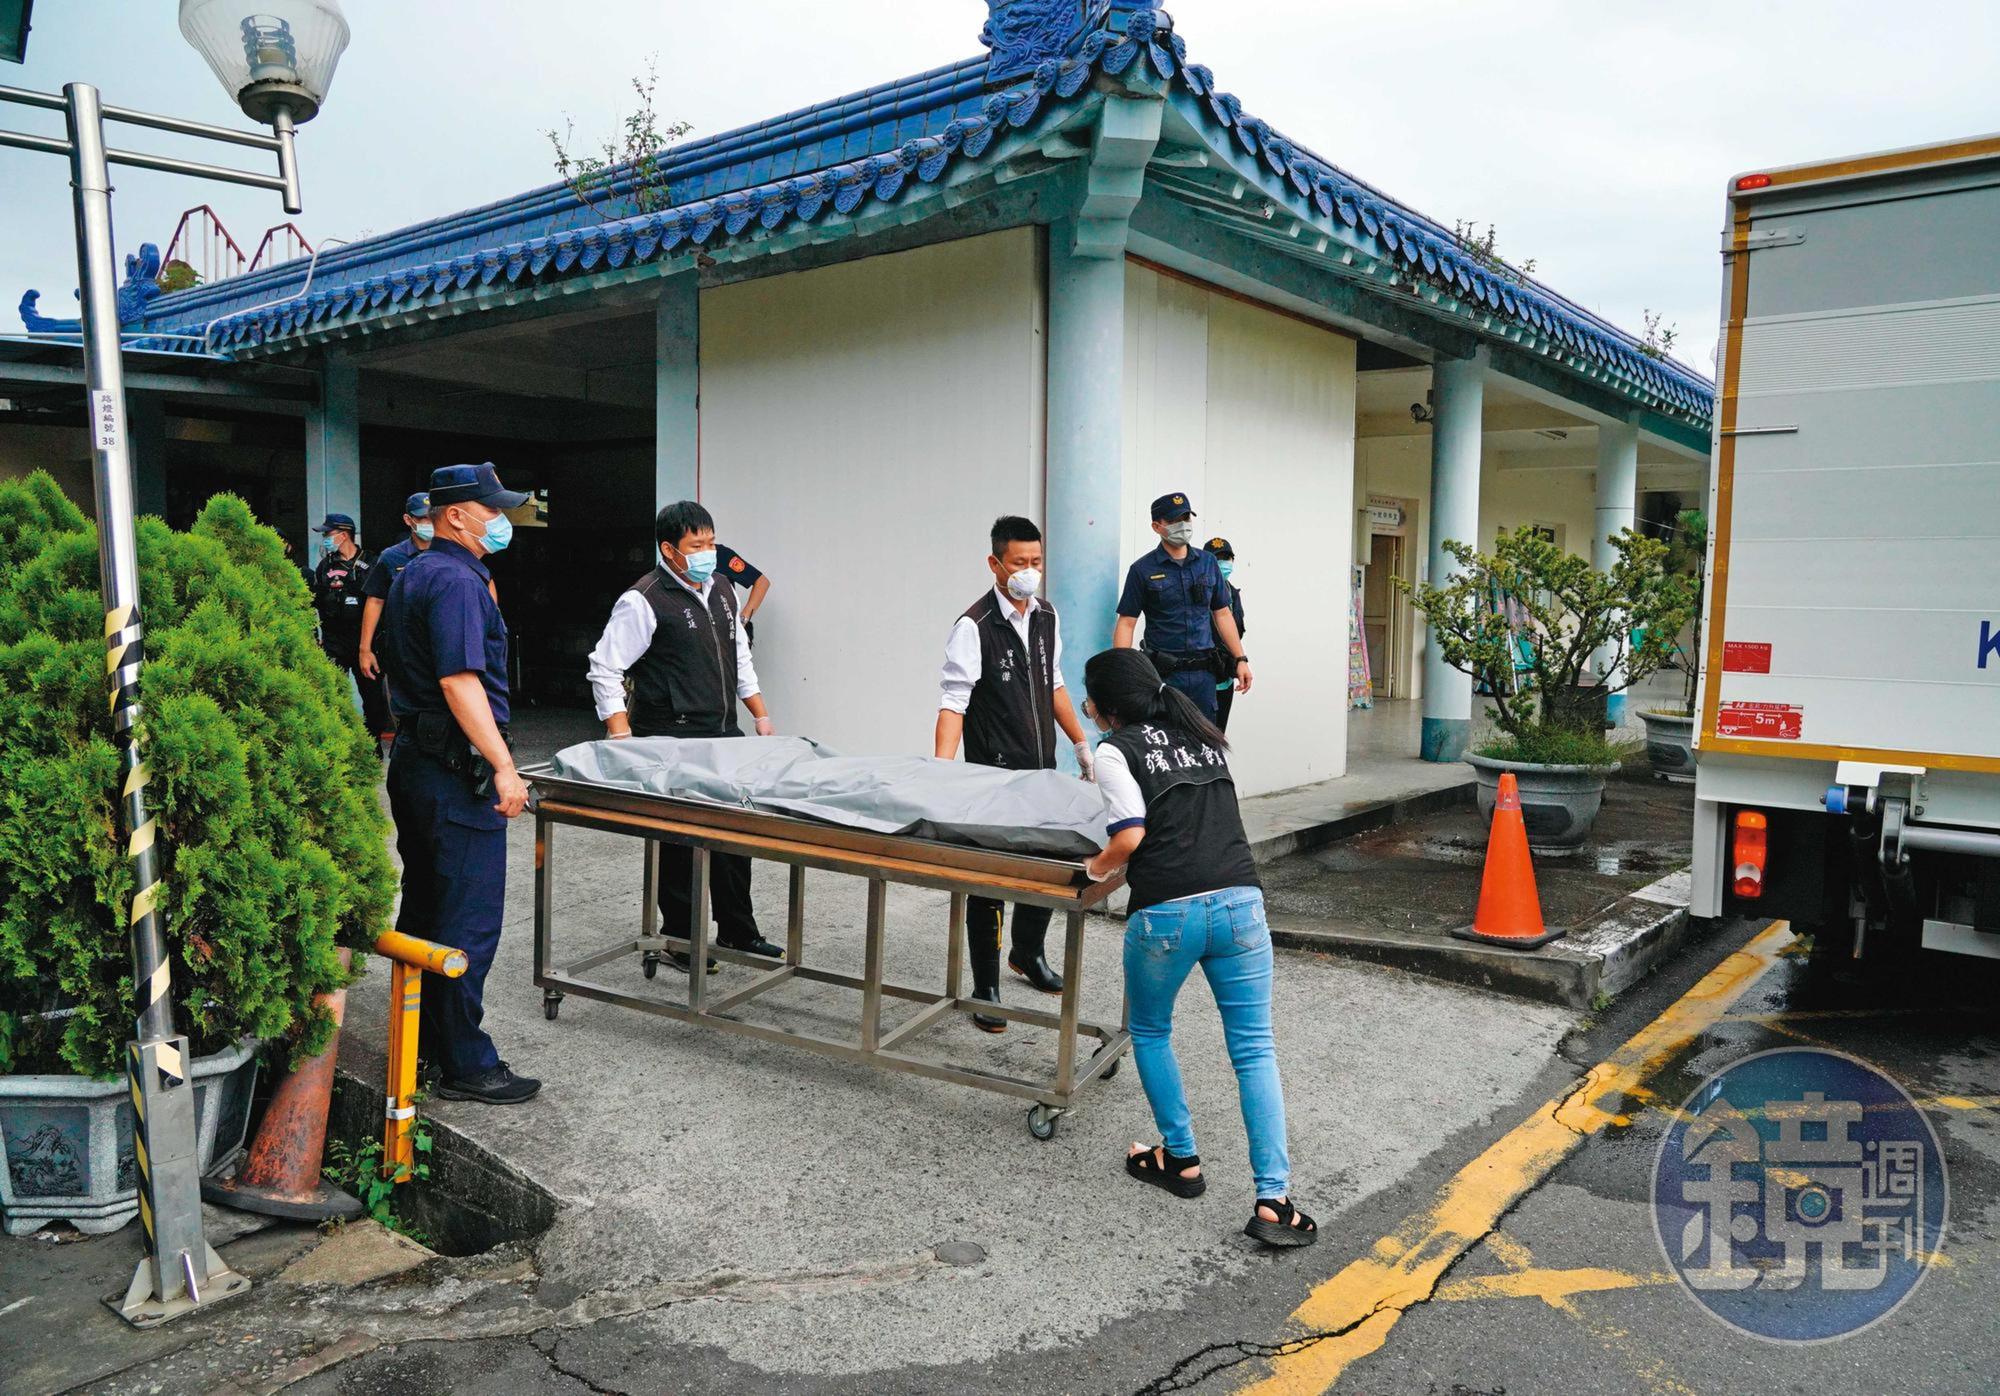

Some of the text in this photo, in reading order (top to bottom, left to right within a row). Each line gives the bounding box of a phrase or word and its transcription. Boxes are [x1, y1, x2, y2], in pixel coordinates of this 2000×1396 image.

[102, 394, 116, 446] 路燈編號 38
[1141, 724, 1169, 746] 南
[1144, 743, 1225, 775] 殯儀館
